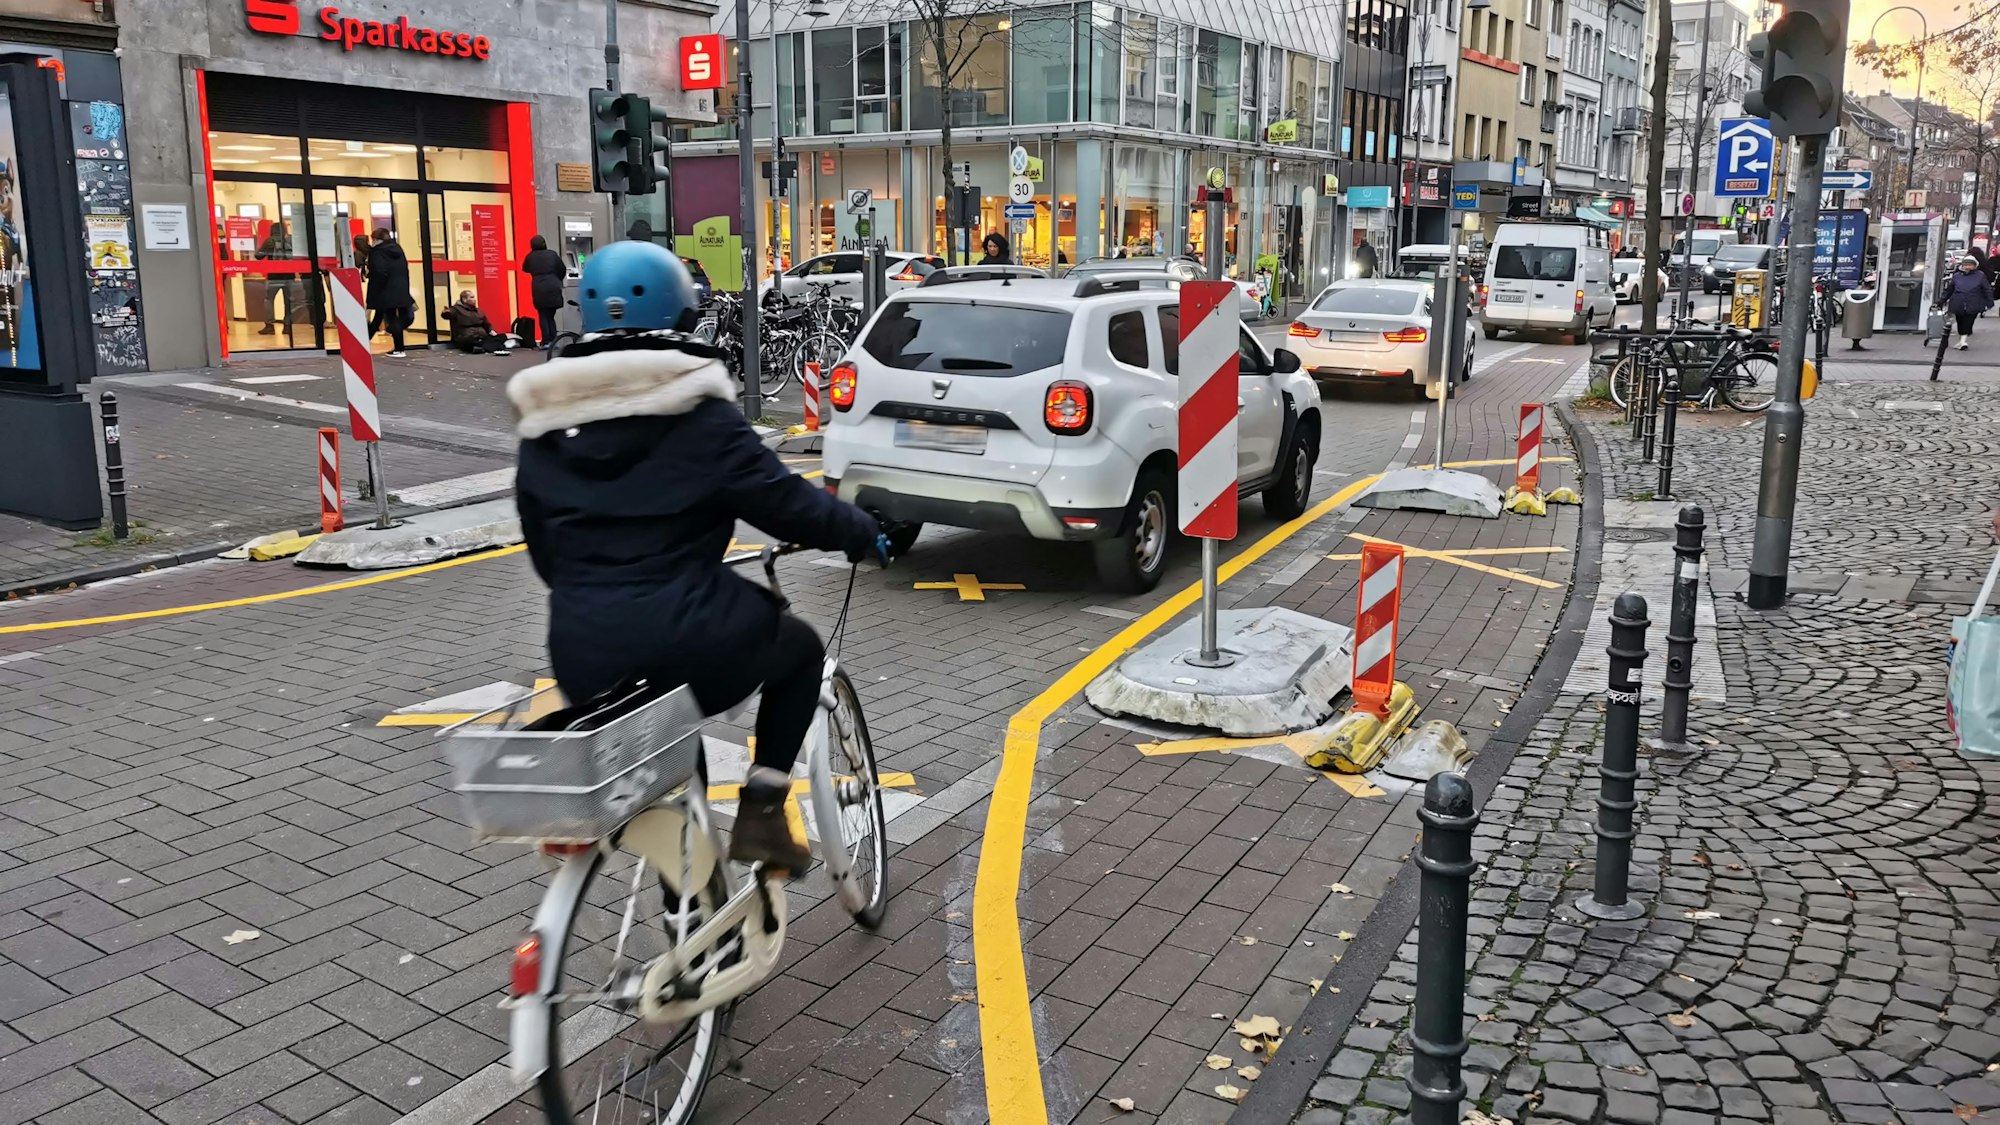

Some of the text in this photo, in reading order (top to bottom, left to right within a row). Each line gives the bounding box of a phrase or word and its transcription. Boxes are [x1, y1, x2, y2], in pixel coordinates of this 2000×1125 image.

[319, 6, 491, 60] Sparkasse
[1729, 136, 1759, 173] P
[1014, 183, 1029, 196] 30
[1728, 181, 1758, 189] BESETZT
[855, 195, 865, 204] 20
[1455, 192, 1476, 200] TEDi
[1908, 192, 1923, 208] T
[1817, 237, 1849, 246] daurt
